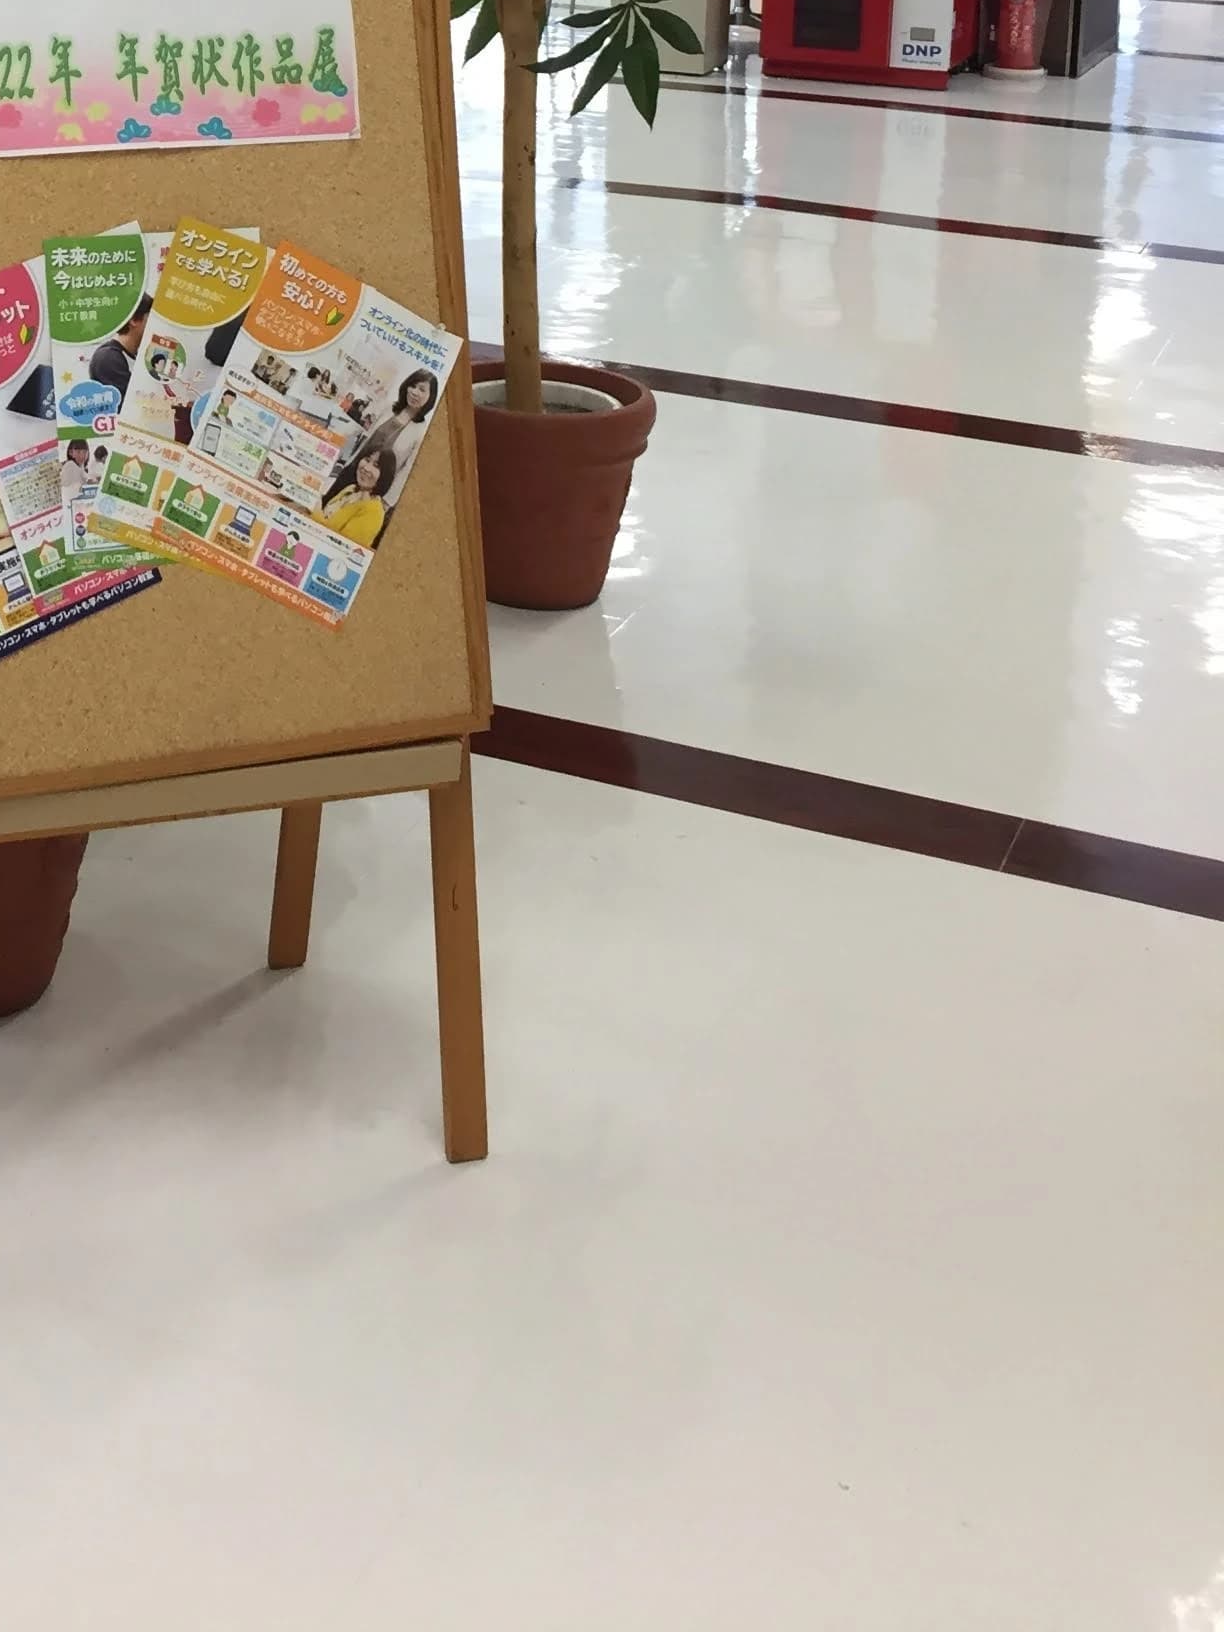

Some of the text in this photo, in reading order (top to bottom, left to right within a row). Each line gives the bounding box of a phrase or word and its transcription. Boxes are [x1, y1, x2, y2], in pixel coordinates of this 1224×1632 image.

[116, 27, 341, 104] 年賀状作品展
[902, 43, 942, 58] DNP
[51, 246, 137, 268] 未来のために
[179, 229, 259, 269] オンライン
[279, 253, 348, 304] 初めての方も
[368, 305, 449, 358] オンライン化の時代に
[19, 515, 63, 541] オンライン
